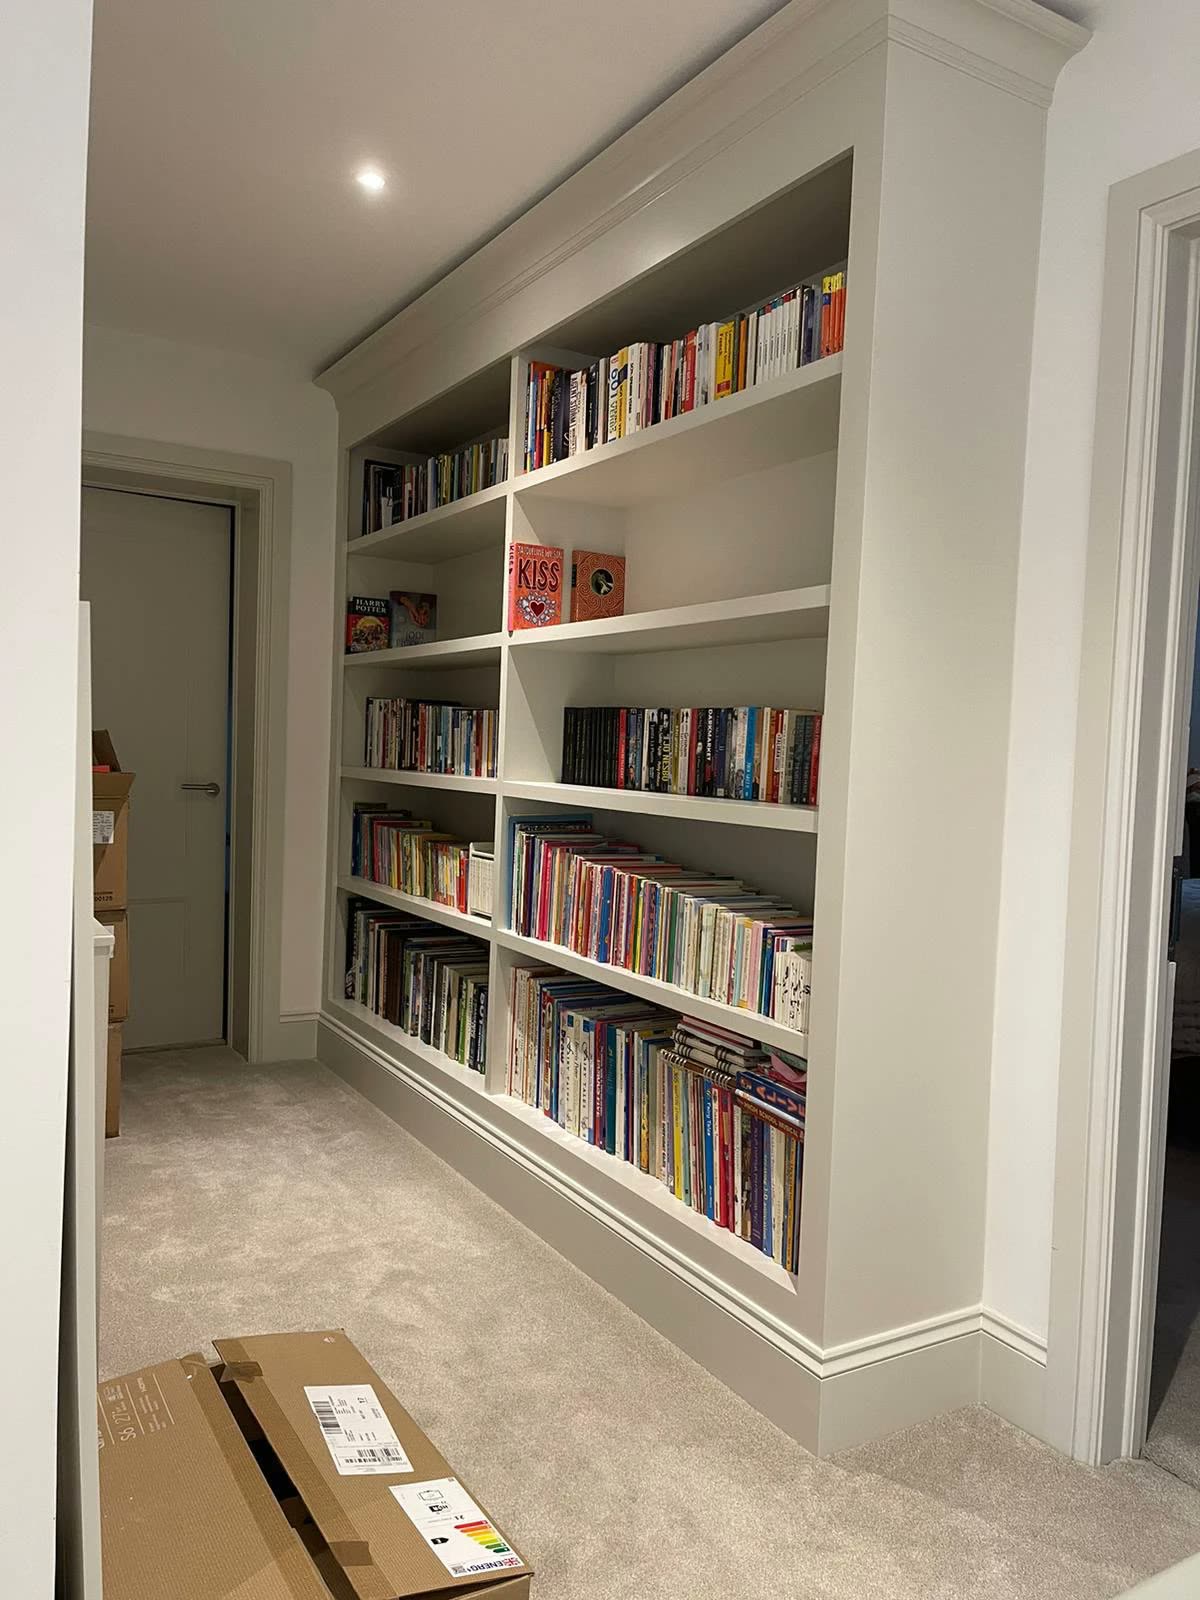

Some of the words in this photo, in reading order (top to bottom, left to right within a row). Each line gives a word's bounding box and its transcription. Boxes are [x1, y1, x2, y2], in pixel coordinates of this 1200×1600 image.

[517, 558, 560, 592] KISS
[355, 605, 386, 613] POTTER
[356, 599, 386, 607] HARRY
[582, 1042, 590, 1079] FAIRY
